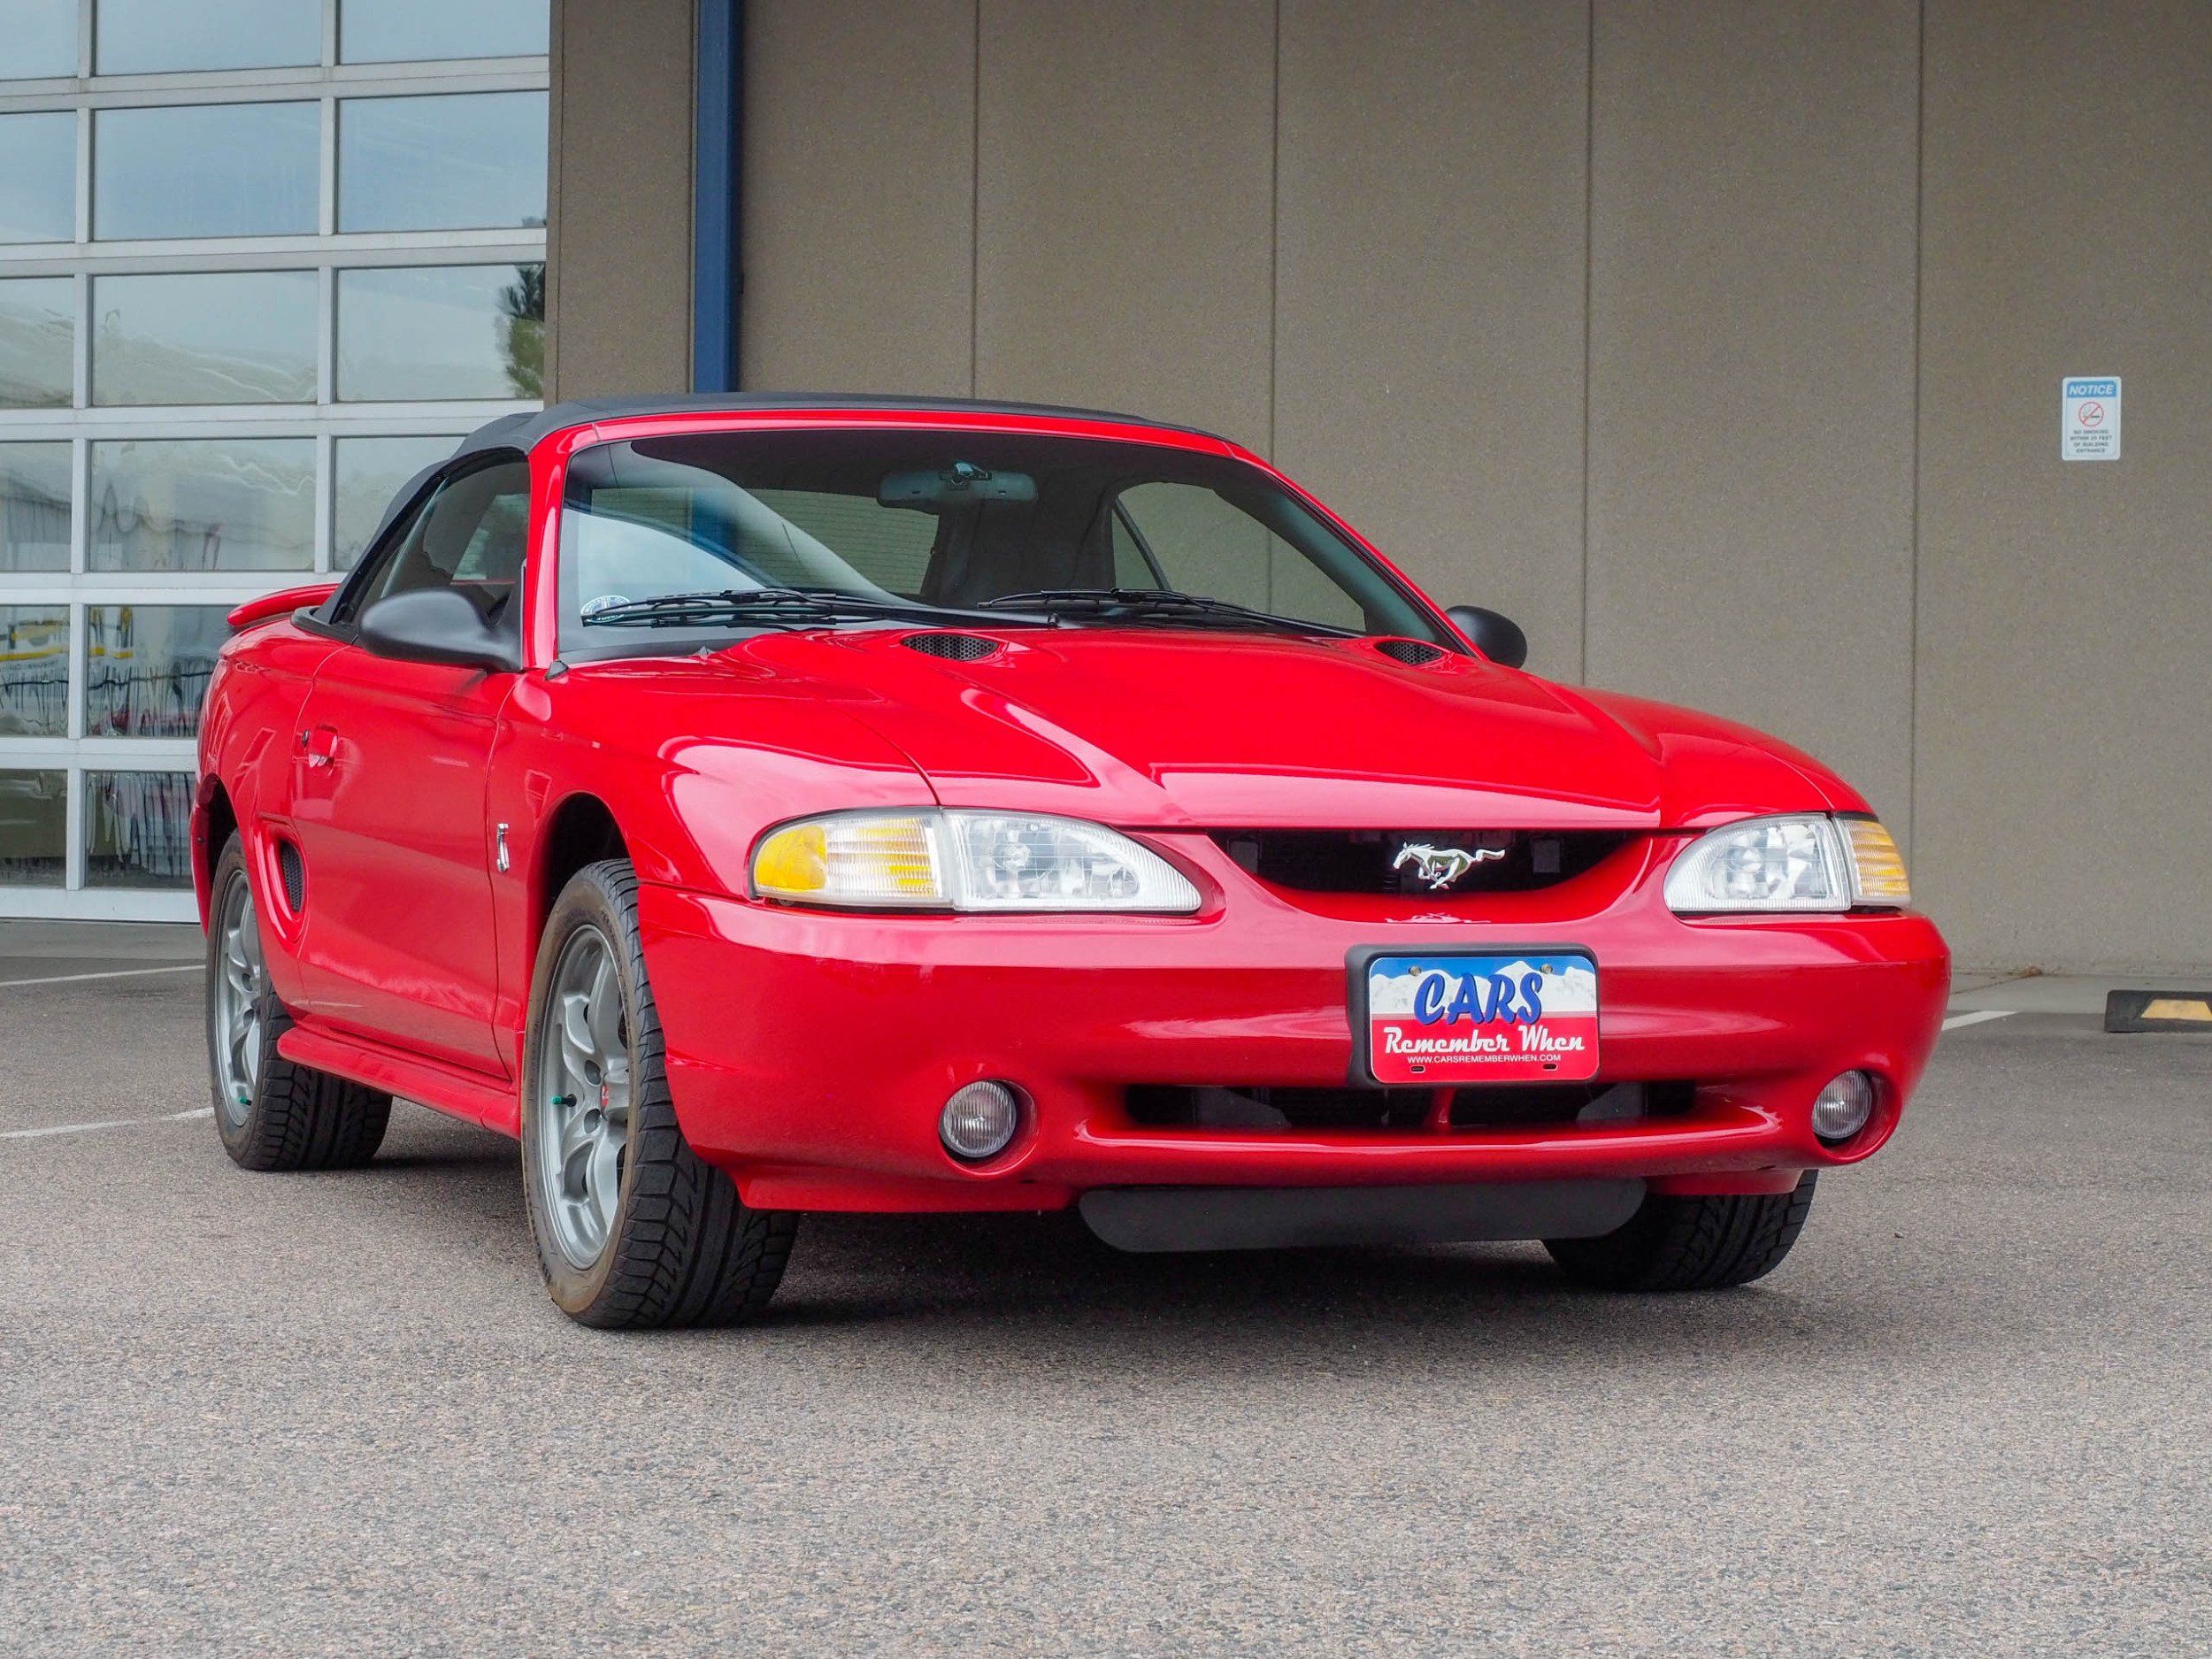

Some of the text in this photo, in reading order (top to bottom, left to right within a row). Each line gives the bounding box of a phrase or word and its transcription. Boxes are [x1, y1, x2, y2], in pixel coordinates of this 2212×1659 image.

[2069, 384, 2115, 396] NOTICE
[1413, 972, 1543, 1025] CARS
[1383, 1025, 1586, 1054] Remember When
[1407, 1055, 1562, 1064] WWW.CARSREMEMBERWHEN.COM
